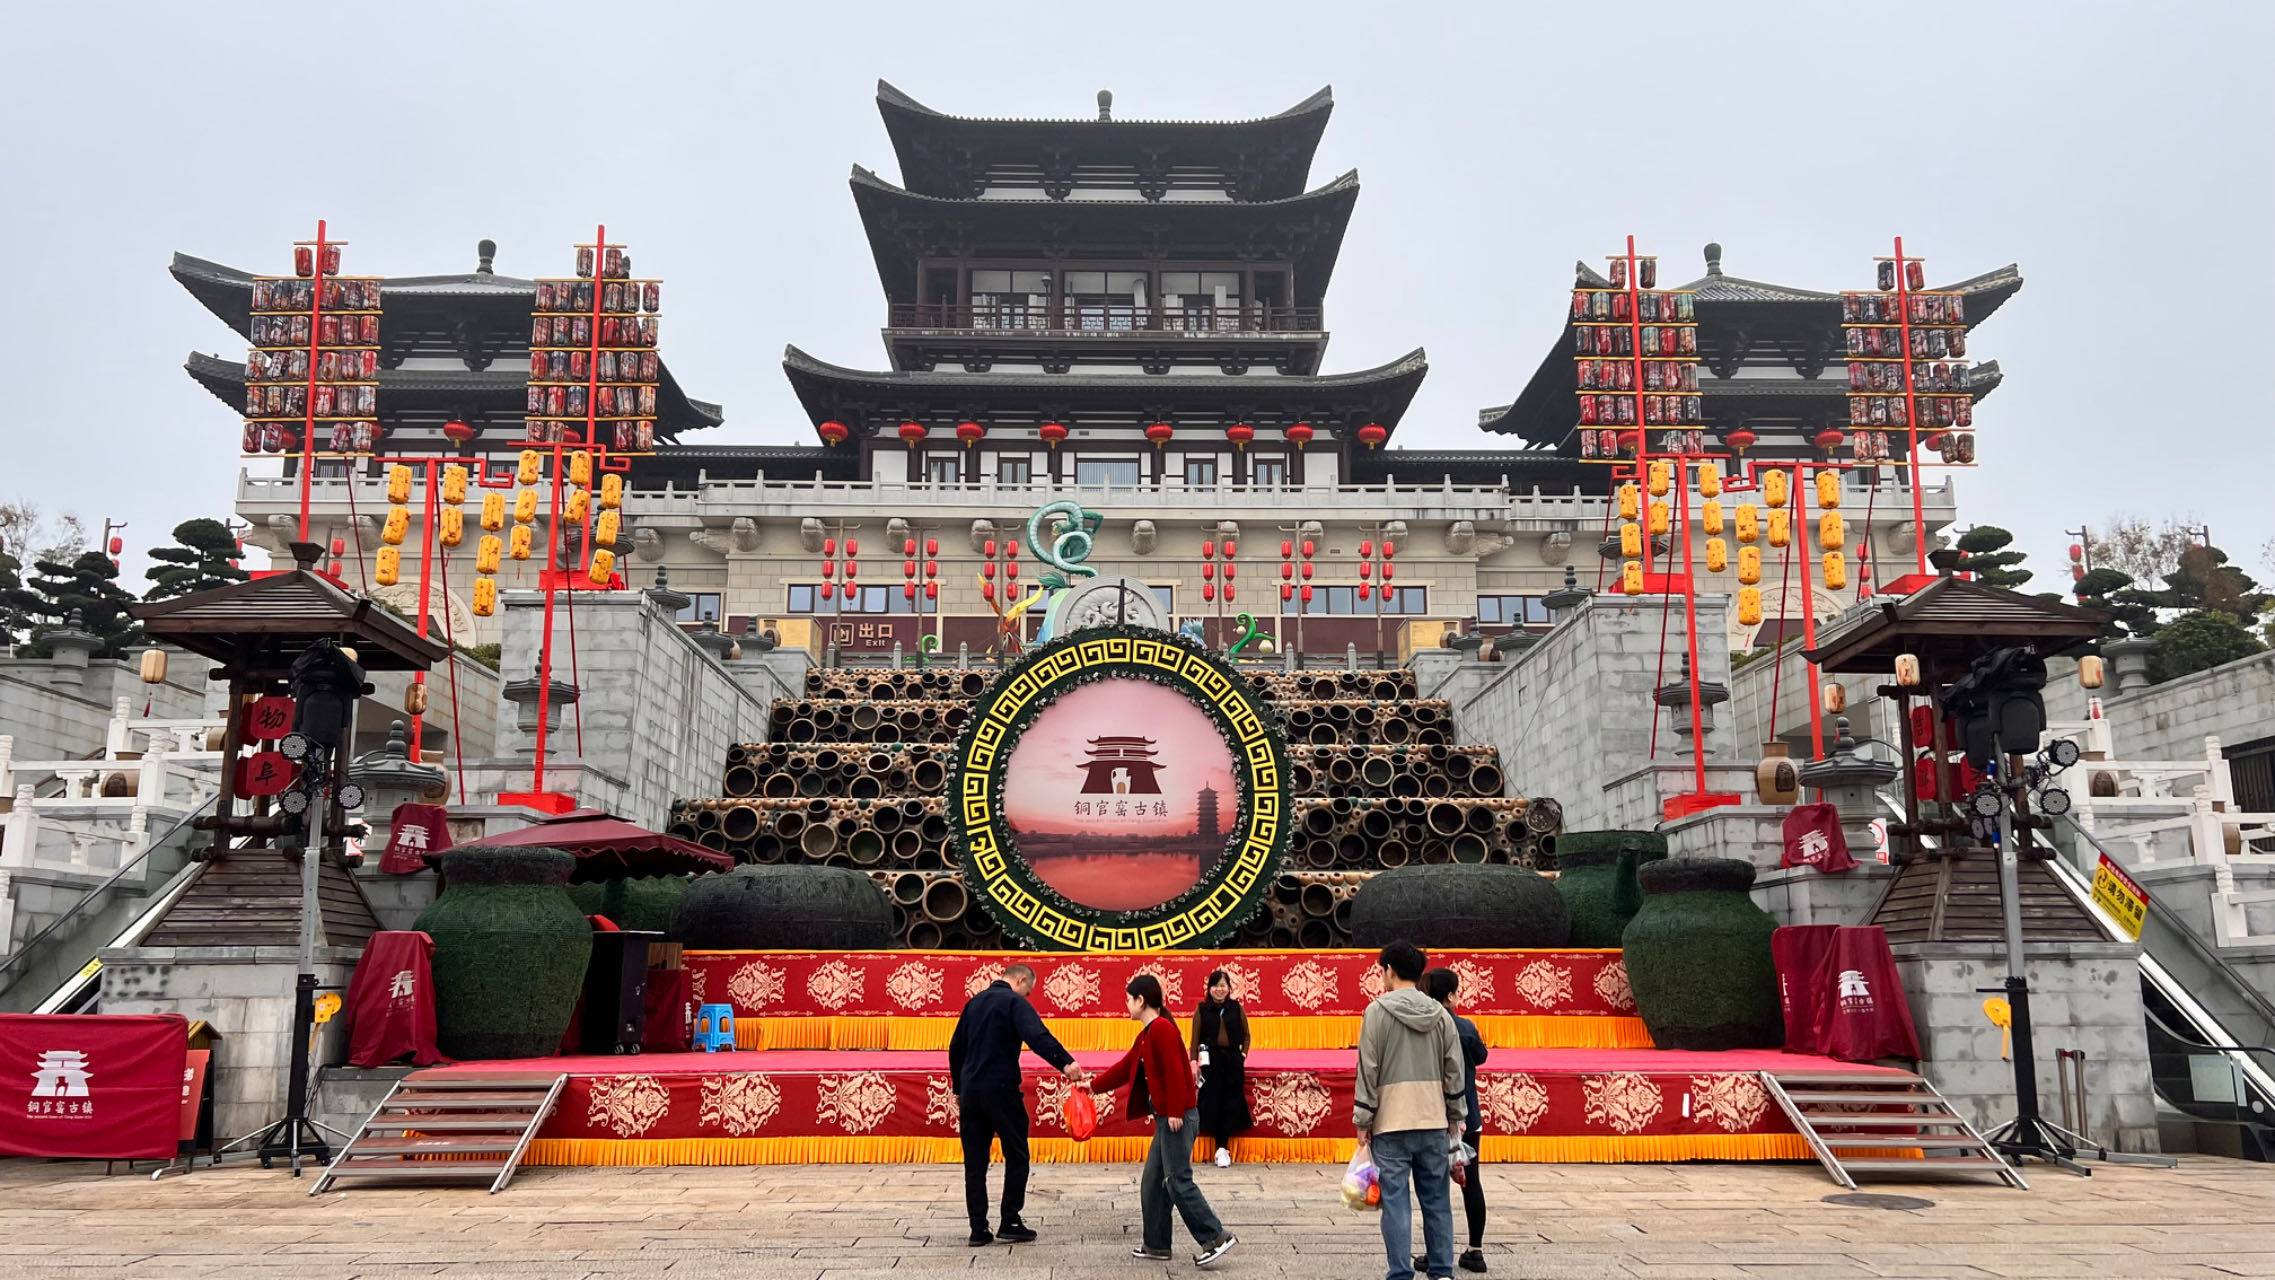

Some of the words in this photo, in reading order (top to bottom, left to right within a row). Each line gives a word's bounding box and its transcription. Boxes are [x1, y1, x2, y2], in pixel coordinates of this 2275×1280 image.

[859, 623, 893, 639] 出口
[865, 639, 886, 647] Exit
[256, 706, 287, 730] 物
